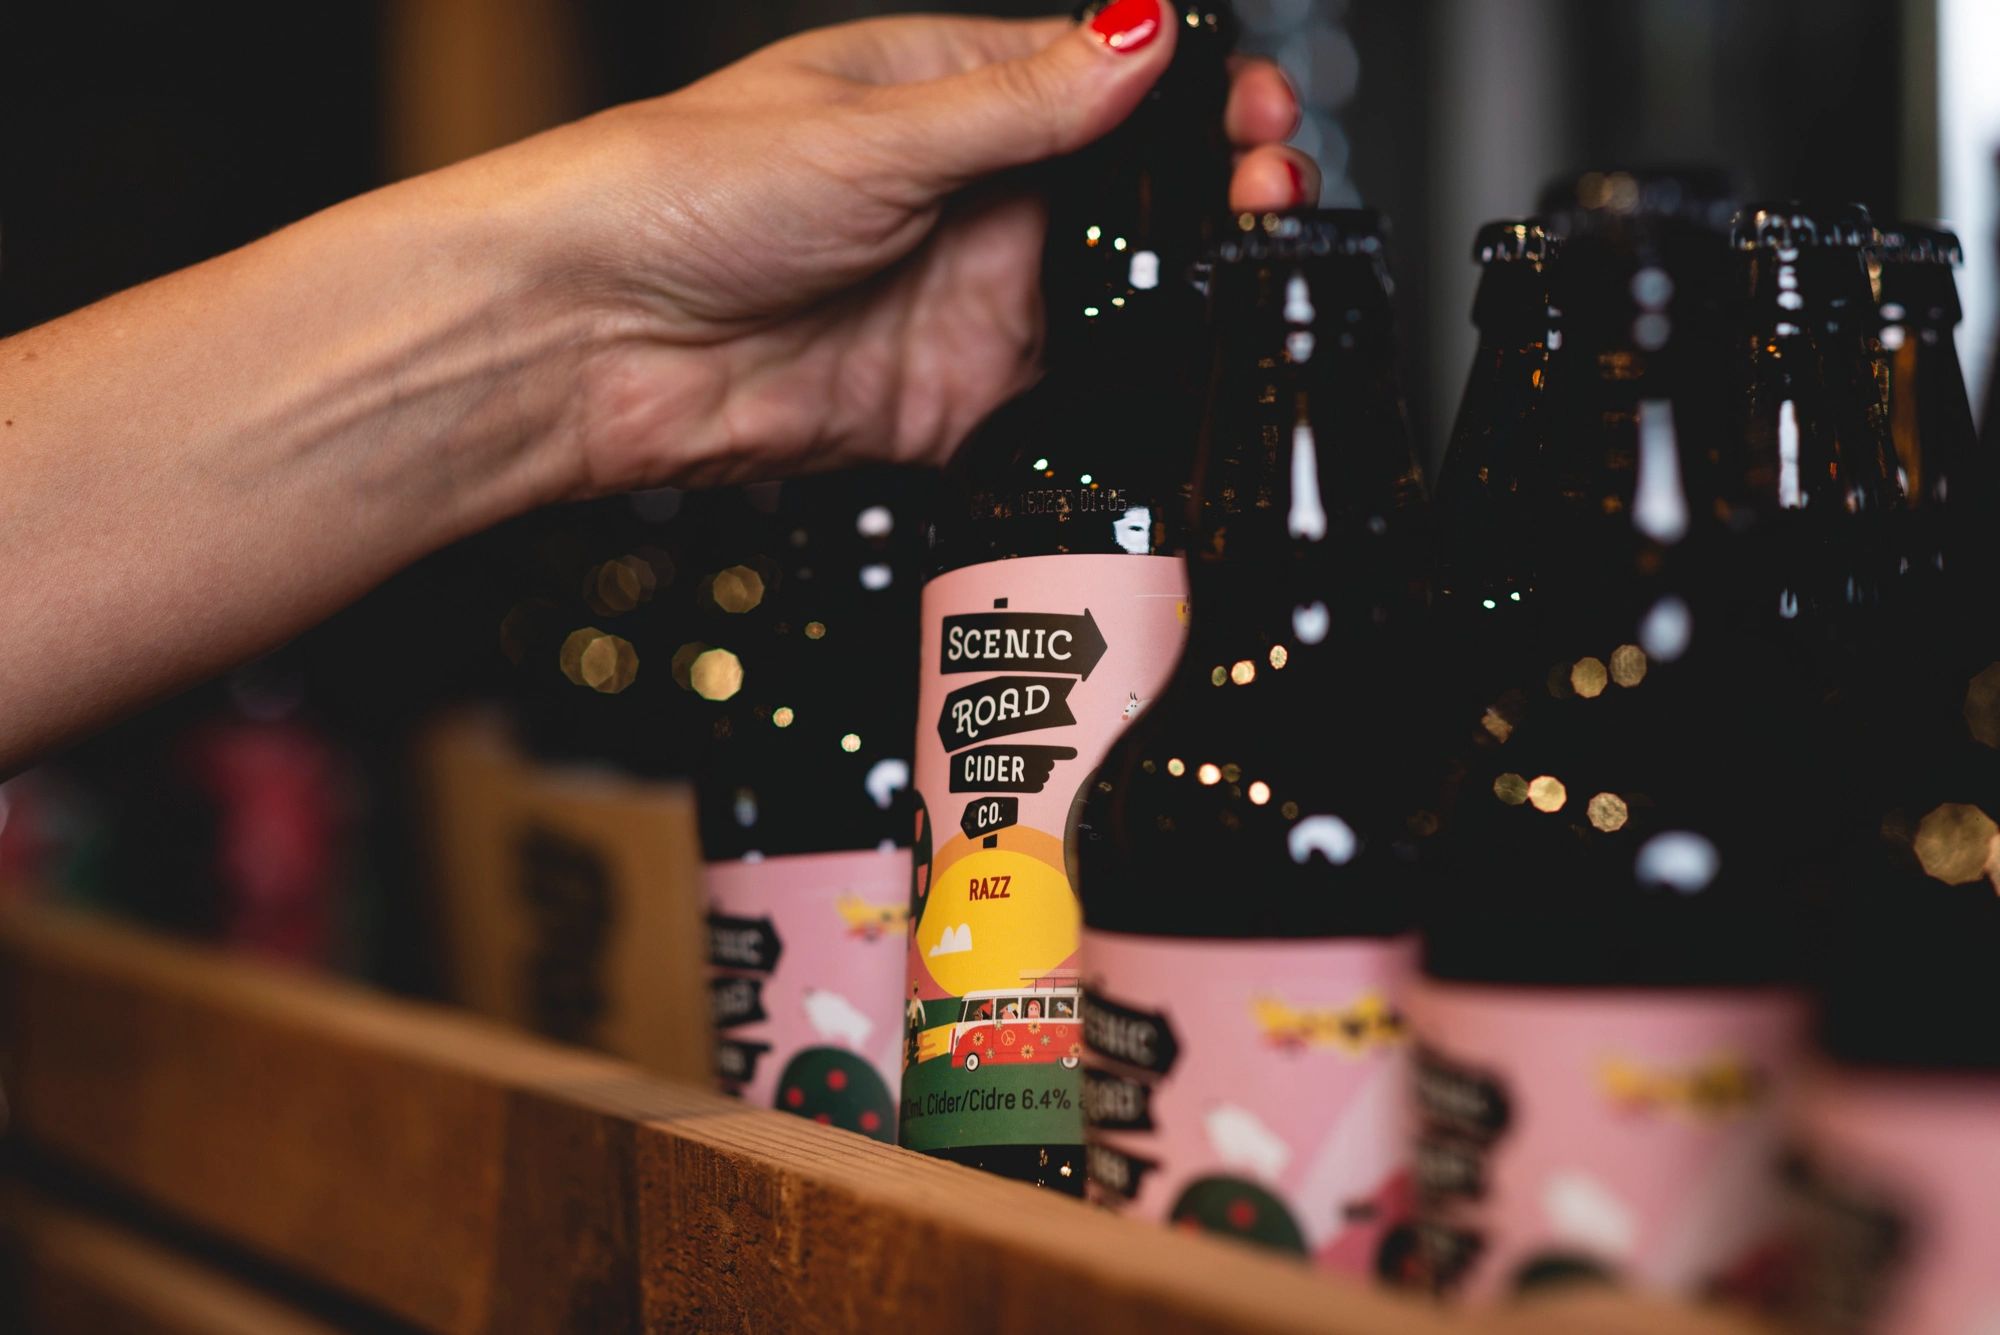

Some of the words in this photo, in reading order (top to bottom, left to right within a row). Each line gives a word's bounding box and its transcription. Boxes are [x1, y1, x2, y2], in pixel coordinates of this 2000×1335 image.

[948, 626, 1073, 661] SCENIC
[951, 684, 1050, 738] ROAD
[964, 755, 1025, 782] CIDER
[977, 802, 1003, 828] CO.
[969, 876, 1012, 901] RAZZ
[927, 1087, 1016, 1116] Cider/Cidre
[1022, 1088, 1072, 1110] 6.4%
